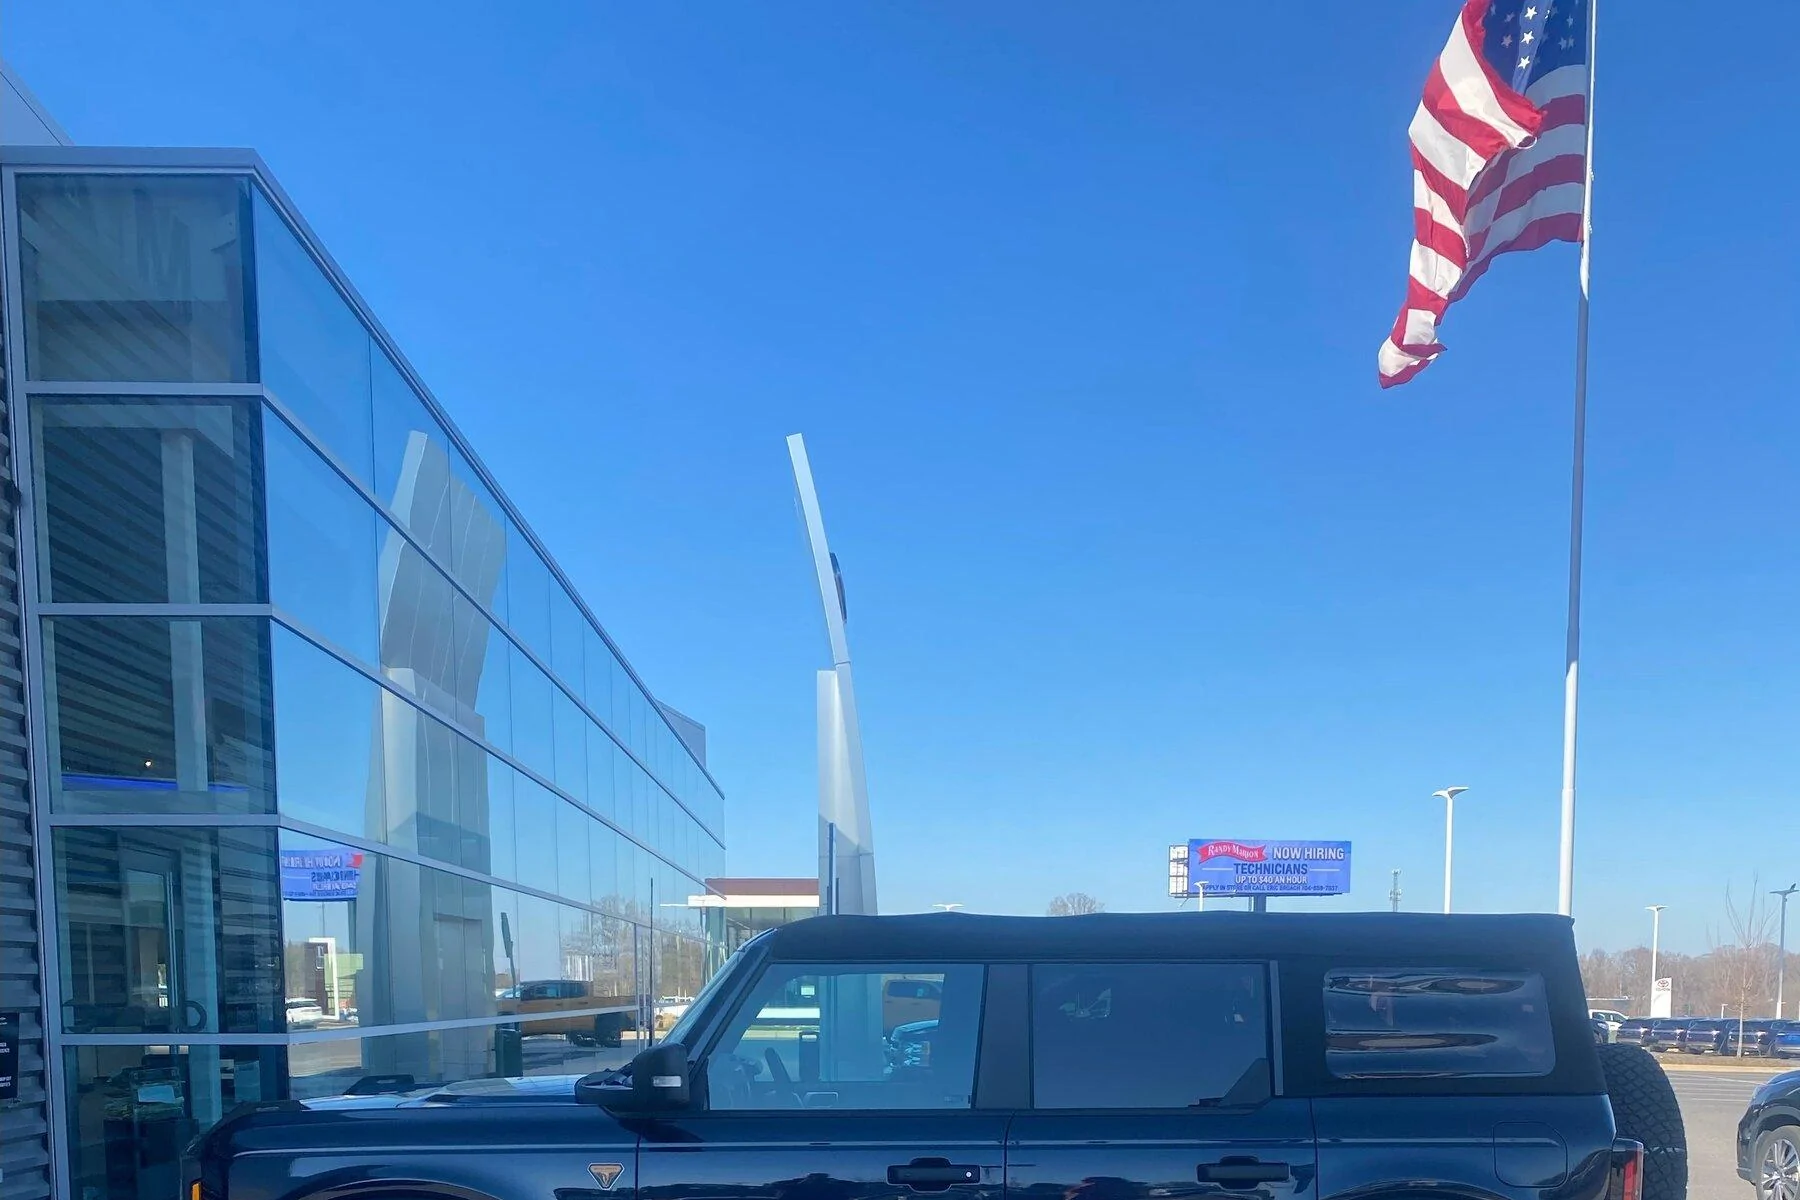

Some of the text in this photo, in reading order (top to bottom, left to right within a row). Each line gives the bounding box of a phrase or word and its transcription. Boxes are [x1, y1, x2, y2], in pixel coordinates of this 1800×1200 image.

[1273, 847, 1344, 860] NOW HIRING
[1234, 863, 1308, 875] TECHNICIANS
[1235, 875, 1308, 885] UP TO $40 AN HOUR
